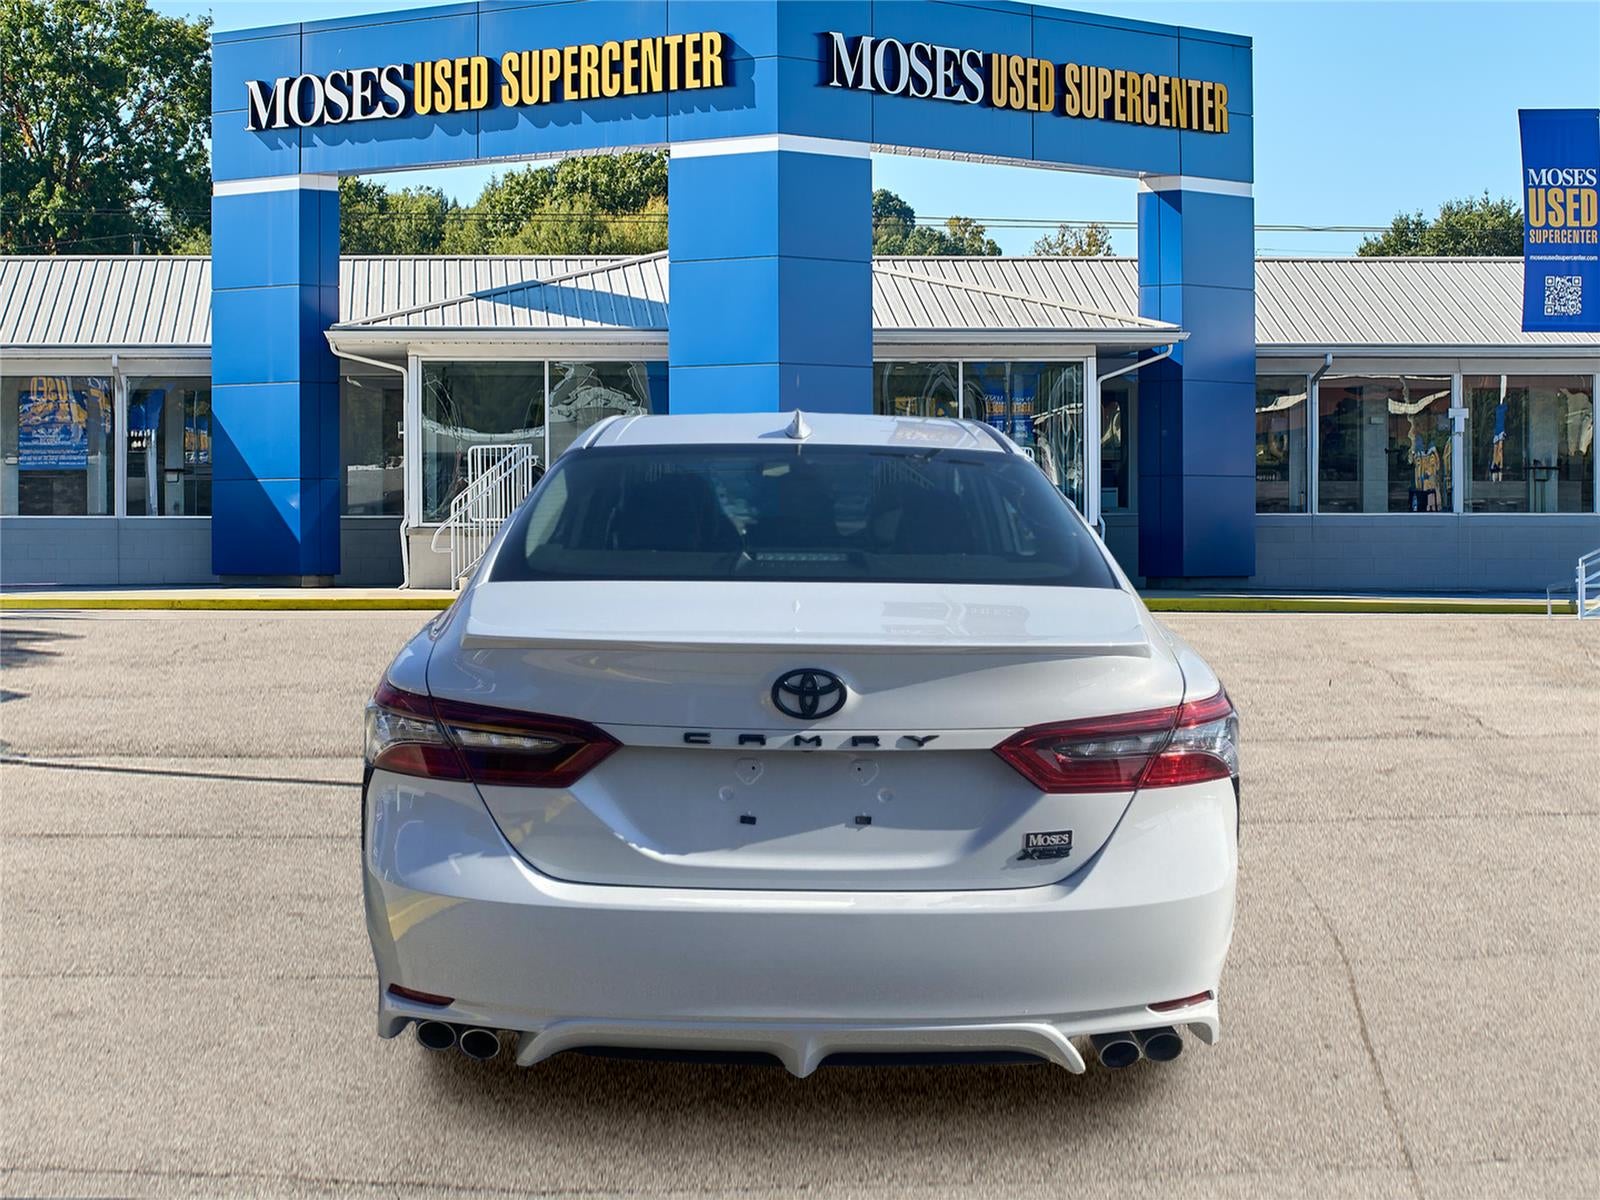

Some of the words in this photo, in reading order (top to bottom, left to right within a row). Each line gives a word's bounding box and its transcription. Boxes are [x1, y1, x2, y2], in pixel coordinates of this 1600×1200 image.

[243, 63, 405, 132] MOSES
[412, 55, 489, 116] USED
[500, 31, 725, 107] SUPERCENTER
[828, 31, 985, 104] MOSES
[991, 52, 1056, 113] USED
[1064, 62, 1230, 134] SUPERCENTER
[1527, 167, 1598, 187] MOSES
[1528, 187, 1598, 228] USED
[1529, 229, 1598, 244] SUPERCENTER
[1529, 254, 1598, 262] mosesusedsupercenter.com
[683, 732, 940, 747] CAMRY
[1028, 833, 1070, 847] MOSES
